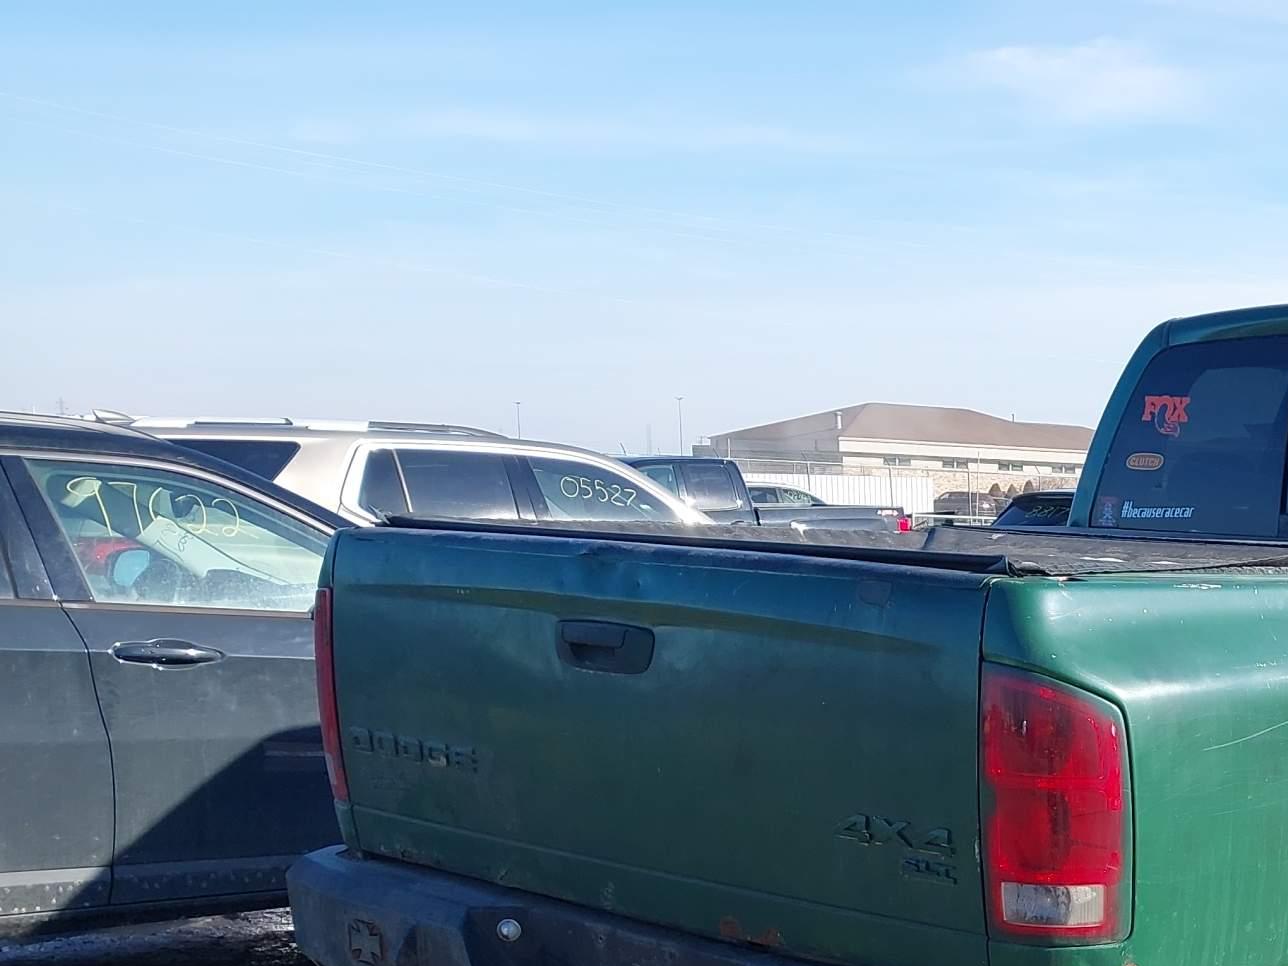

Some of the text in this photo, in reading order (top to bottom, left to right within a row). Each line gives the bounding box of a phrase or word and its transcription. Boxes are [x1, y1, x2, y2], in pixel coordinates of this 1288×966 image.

[1142, 396, 1190, 427] FOX
[1129, 456, 1161, 467] CLUTCH
[560, 475, 637, 507] 05527
[1121, 500, 1194, 519] #becauseracecar
[349, 726, 480, 775] DODGE
